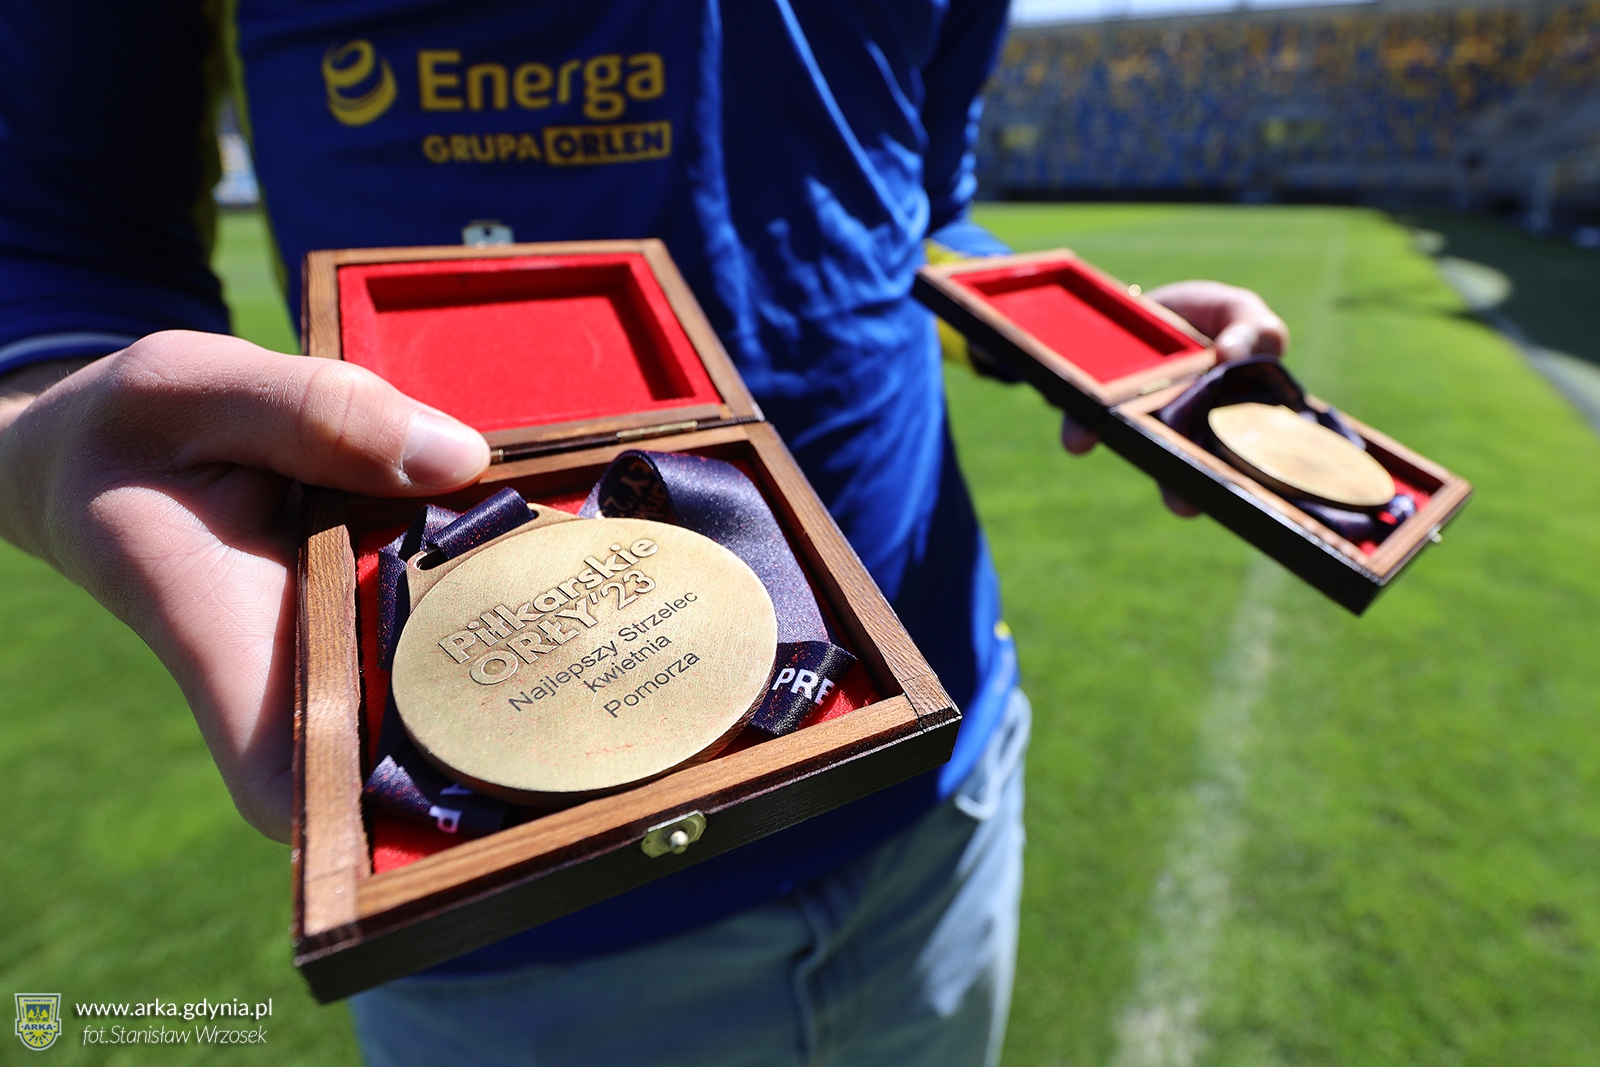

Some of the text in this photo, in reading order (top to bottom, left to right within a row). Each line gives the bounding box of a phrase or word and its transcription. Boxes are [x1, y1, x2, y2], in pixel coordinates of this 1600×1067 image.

[418, 50, 665, 120] Energa
[421, 126, 664, 164] GRUPA ORLEN
[437, 538, 658, 664] Piłkarskie
[508, 590, 698, 712] Najlepszy Strzelec
[583, 633, 672, 693] kwietnia
[603, 652, 700, 719] Pomorza
